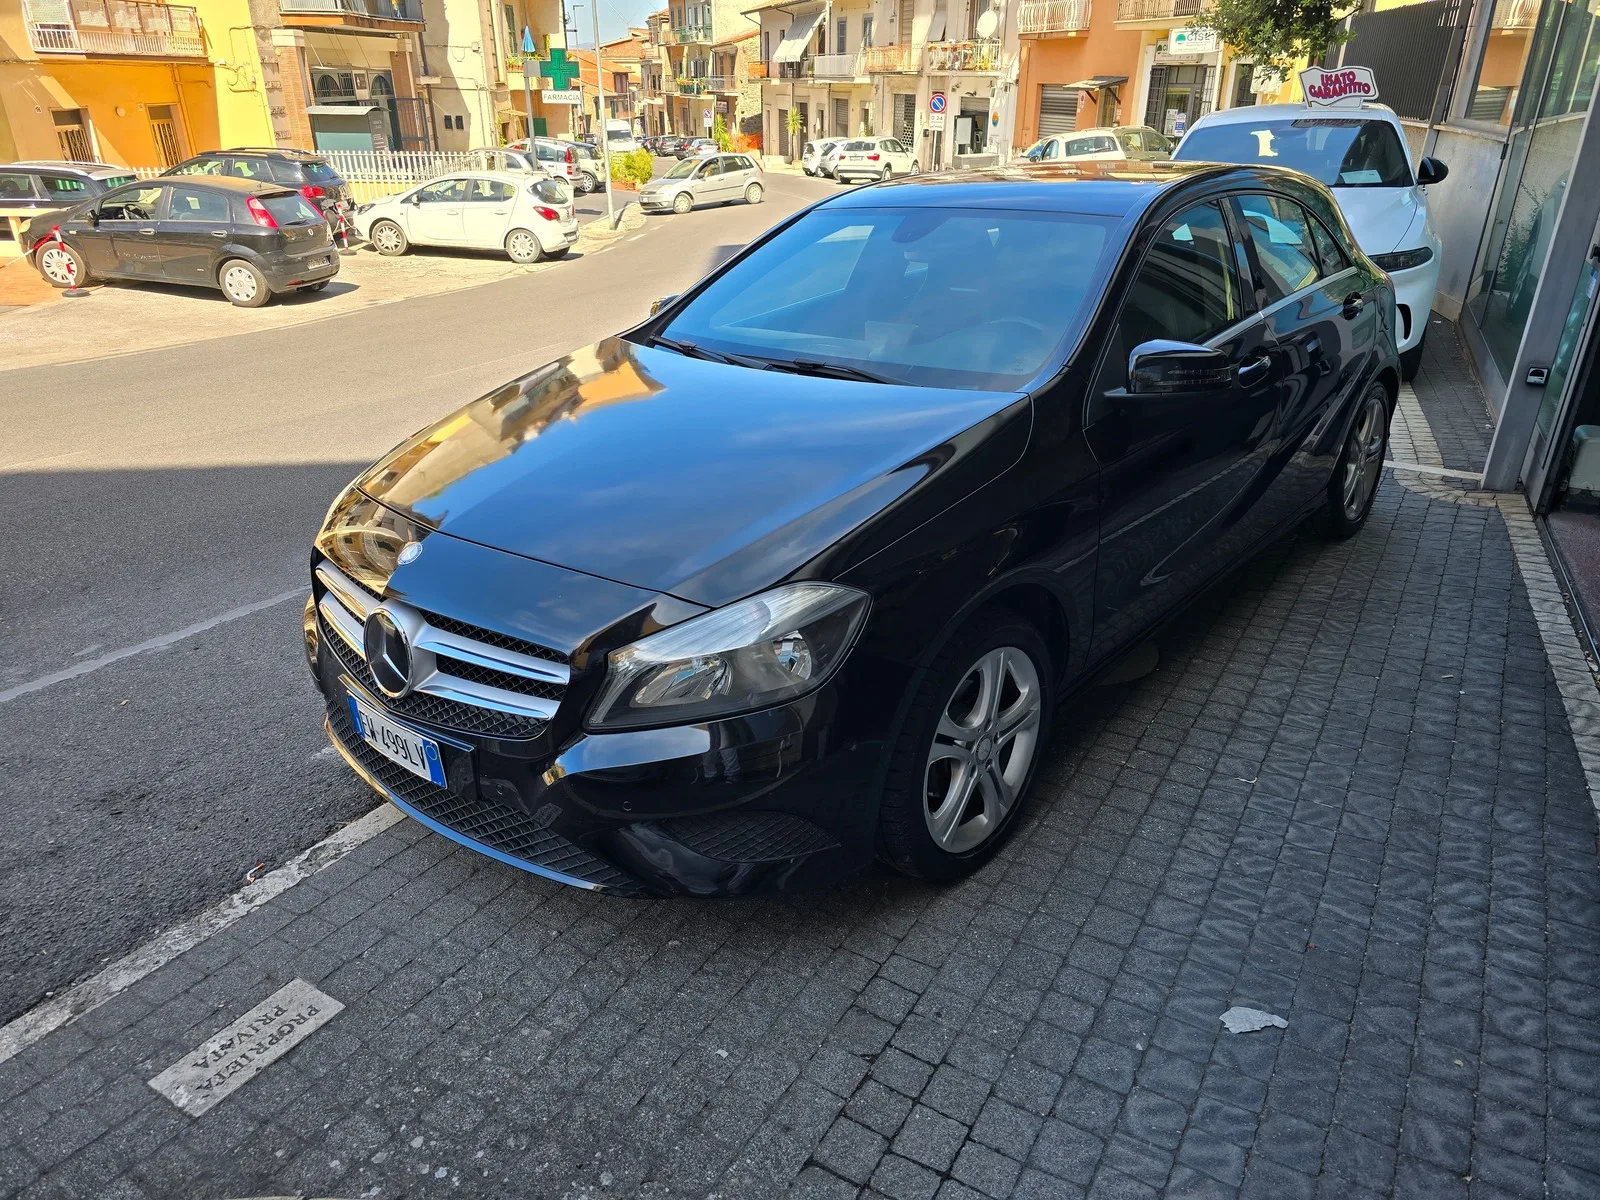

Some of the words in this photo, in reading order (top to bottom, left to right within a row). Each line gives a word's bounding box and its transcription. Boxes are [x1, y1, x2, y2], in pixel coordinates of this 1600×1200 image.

[1321, 71, 1356, 87] USATO
[544, 93, 580, 101] FARMACIA
[1309, 82, 1370, 99] GARANTITO
[192, 1004, 288, 1069] PRIVATA
